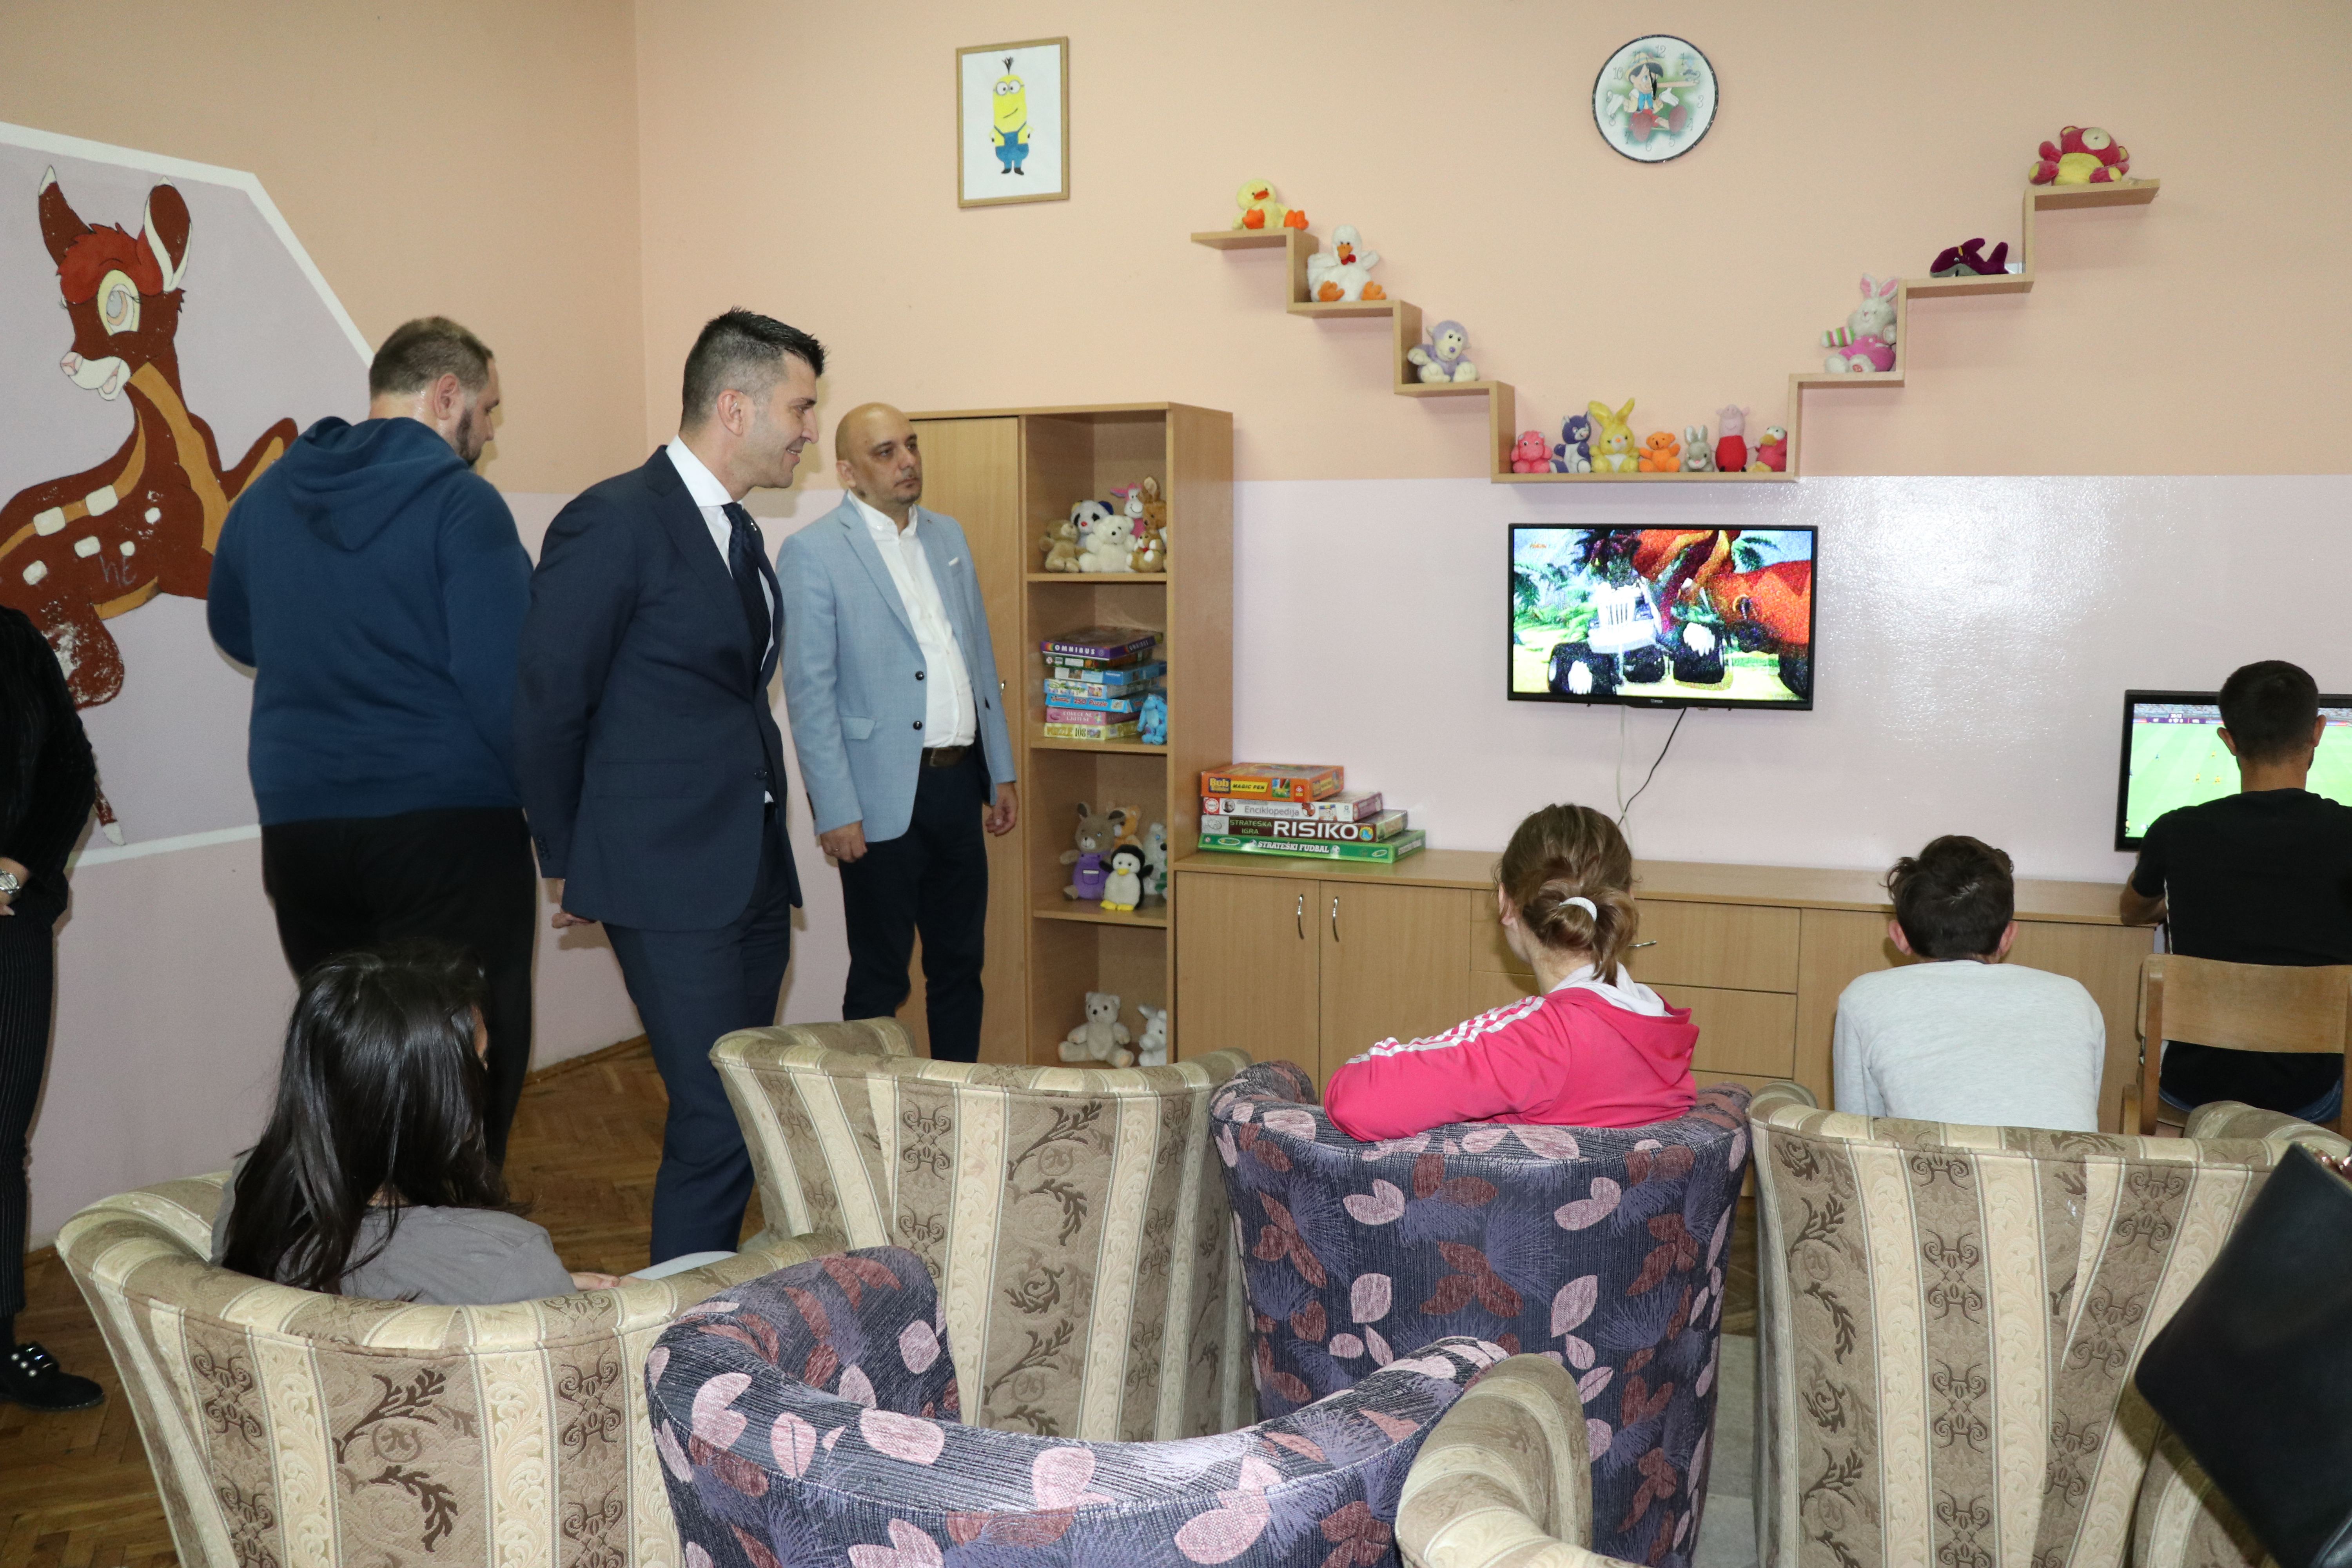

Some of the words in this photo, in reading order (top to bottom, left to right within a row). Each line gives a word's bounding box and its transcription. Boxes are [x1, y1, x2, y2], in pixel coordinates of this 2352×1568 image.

[1655, 45, 1666, 58] 12
[1681, 52, 1684, 65] 1
[1613, 67, 1623, 80] 10
[1606, 90, 1613, 102] 9
[1697, 95, 1704, 108] 3
[1609, 113, 1616, 126] 8
[1687, 118, 1693, 131] 4
[1625, 131, 1630, 144] 7
[1669, 134, 1675, 147] 5
[1646, 140, 1652, 152] 6
[1054, 644, 1095, 655] OMNIBUS
[1075, 727, 1086, 737] 108
[1210, 778, 1230, 787] Bob
[1245, 806, 1299, 817] Enciklopedija
[1273, 821, 1358, 840] RISIKO
[1299, 844, 1330, 853] FUDBAL
